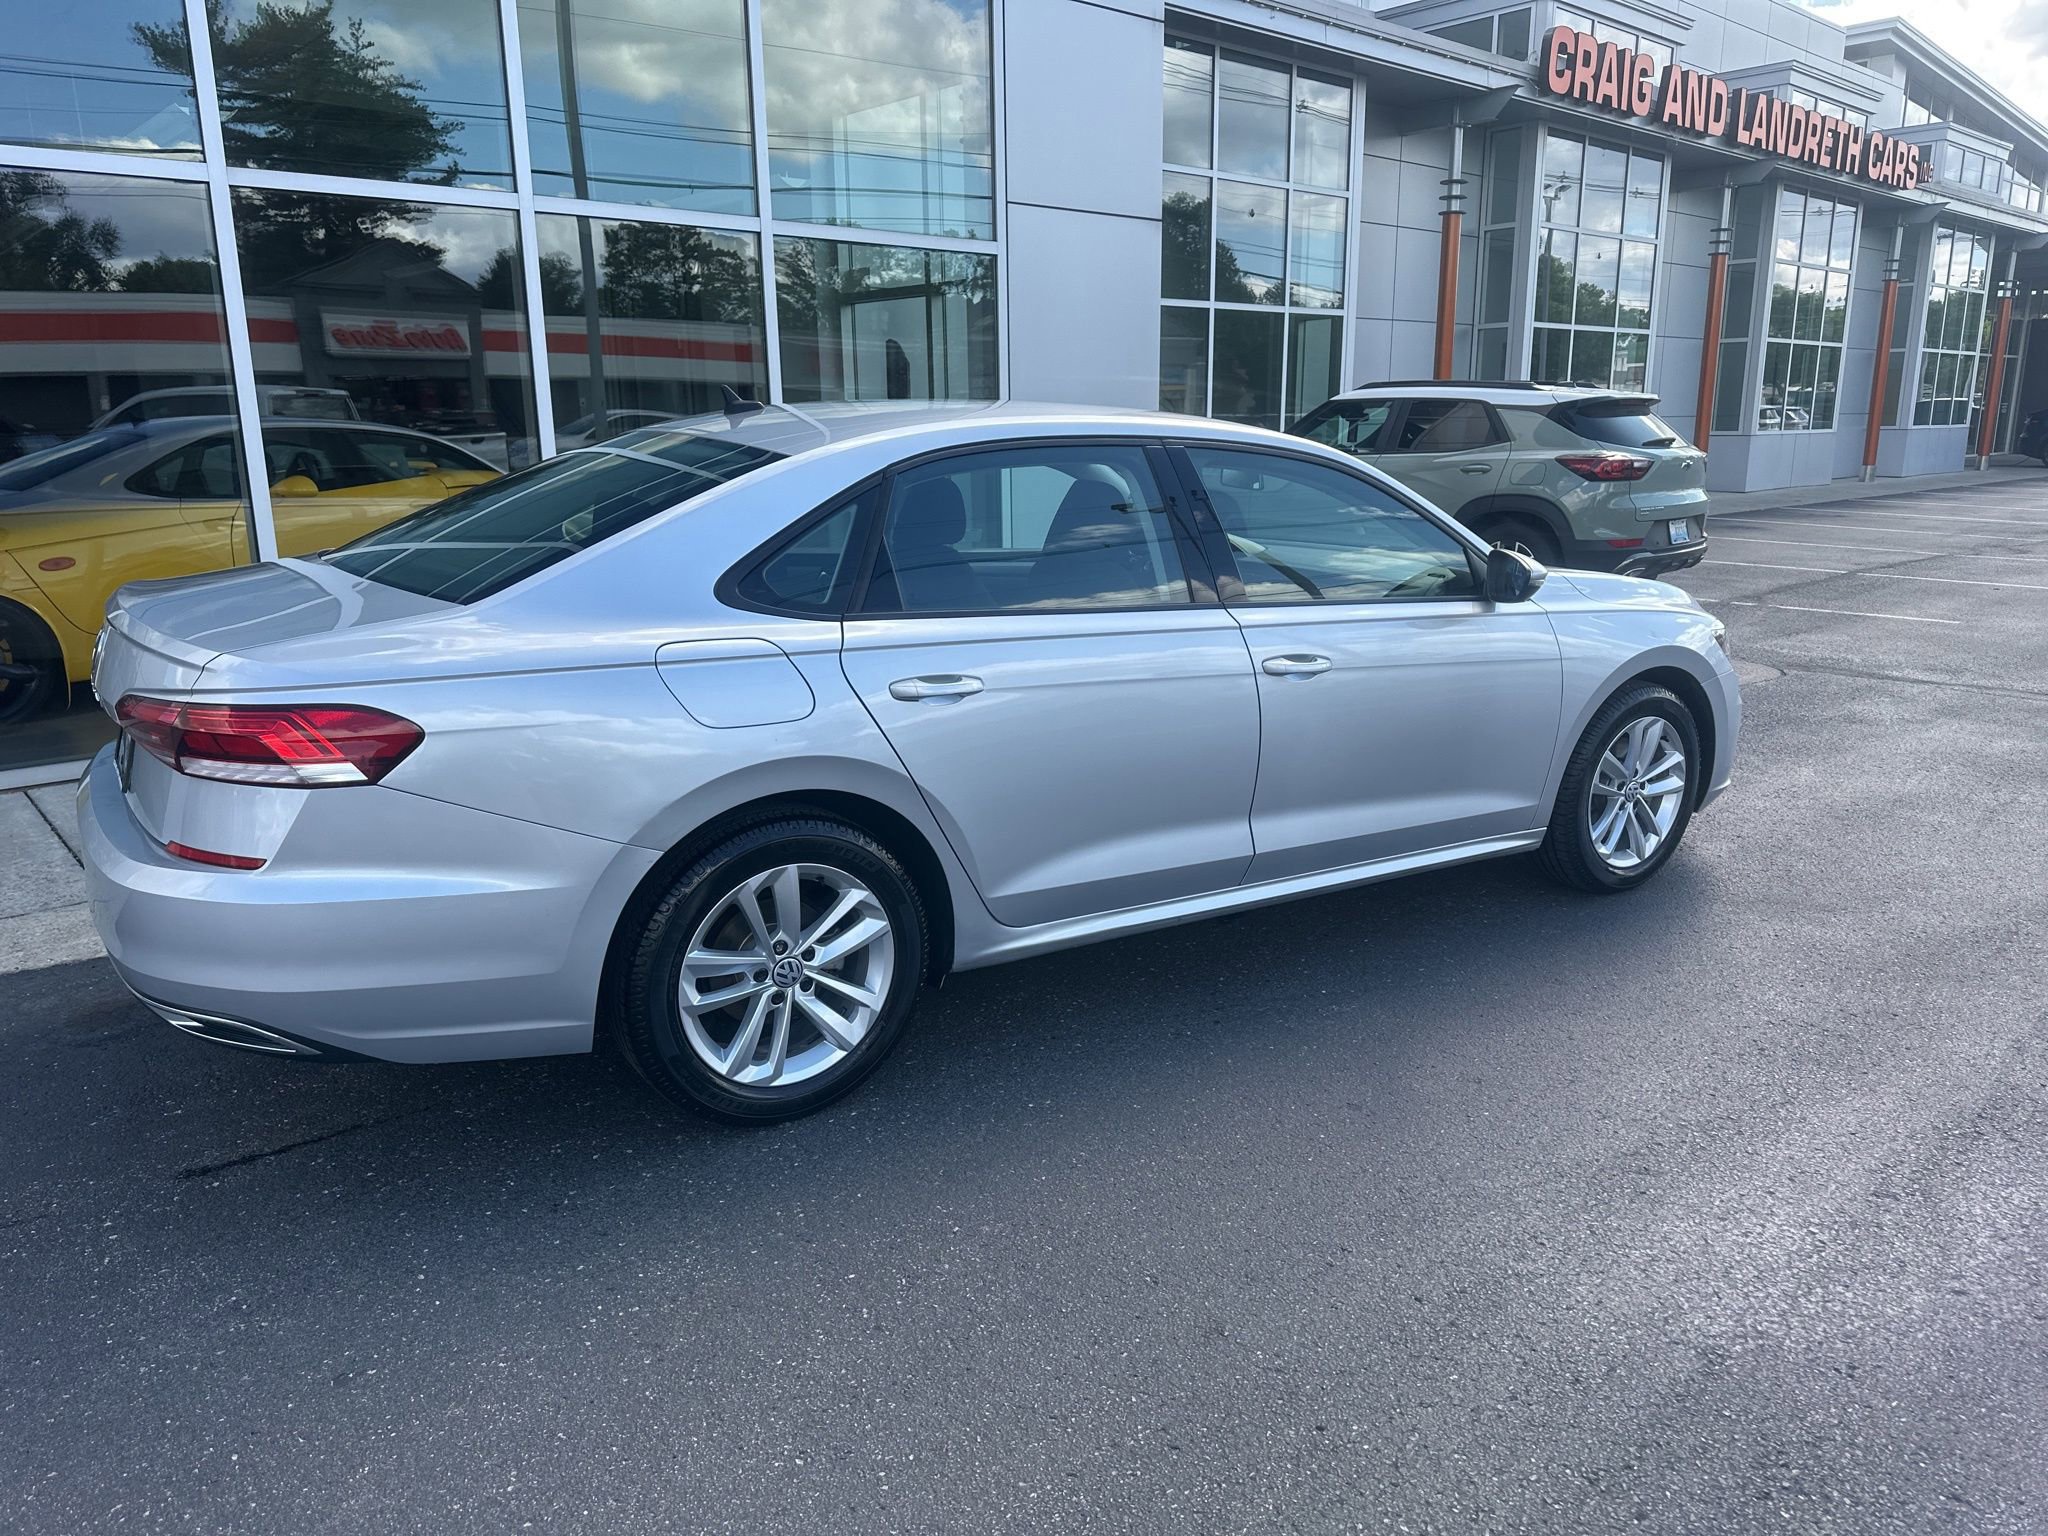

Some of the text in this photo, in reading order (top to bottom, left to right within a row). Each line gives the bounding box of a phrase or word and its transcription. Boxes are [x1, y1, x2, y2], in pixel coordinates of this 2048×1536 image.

[1546, 25, 1655, 117] CRAIG
[1661, 63, 1729, 137] AND
[1736, 86, 1864, 176] LANDRETH
[1867, 130, 1920, 190] CARS
